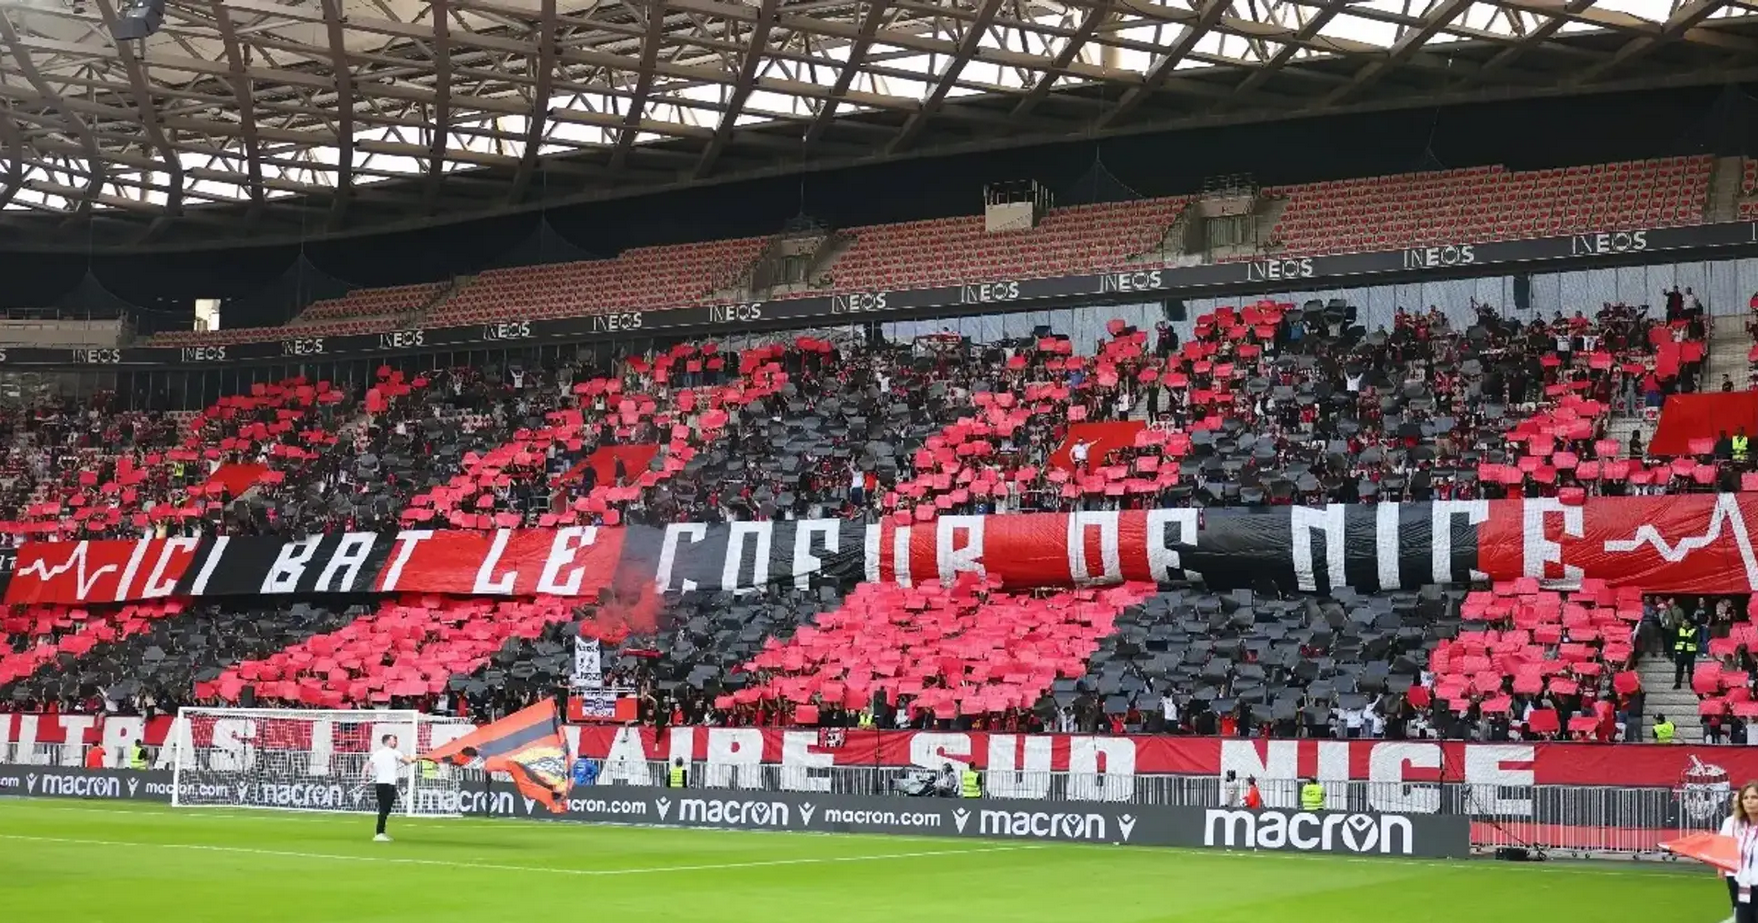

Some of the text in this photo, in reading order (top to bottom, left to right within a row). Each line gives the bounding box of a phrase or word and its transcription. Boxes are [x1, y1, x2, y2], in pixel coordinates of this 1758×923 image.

[1572, 231, 1647, 255] INEOS
[1403, 245, 1475, 269] INEOS
[1247, 258, 1313, 281] INEOS
[961, 281, 1020, 303] INEOS
[1100, 270, 1162, 293] INEOS
[708, 302, 762, 322] INEOS
[832, 291, 887, 313] INEOS
[482, 320, 531, 340] INEOS
[593, 311, 643, 332] INEOS
[282, 337, 324, 356] INEOS
[380, 328, 424, 349] INEOS
[72, 348, 120, 364] INEOS
[181, 346, 226, 363] INEOS
[114, 531, 230, 601] ICI
[260, 531, 432, 597] BAT
[473, 525, 599, 596] LE
[1067, 507, 1206, 589] DE
[1291, 496, 1584, 592] NICE
[0, 714, 257, 770] LTRAS
[909, 732, 1137, 802] SUD
[1219, 739, 1536, 816] NICE
[42, 774, 120, 797] macron
[415, 787, 514, 815] macron
[566, 798, 647, 814] cron.com
[678, 798, 789, 826] macron
[824, 808, 941, 828] macron.com
[979, 809, 1105, 840] macron
[1203, 808, 1414, 855] macron
